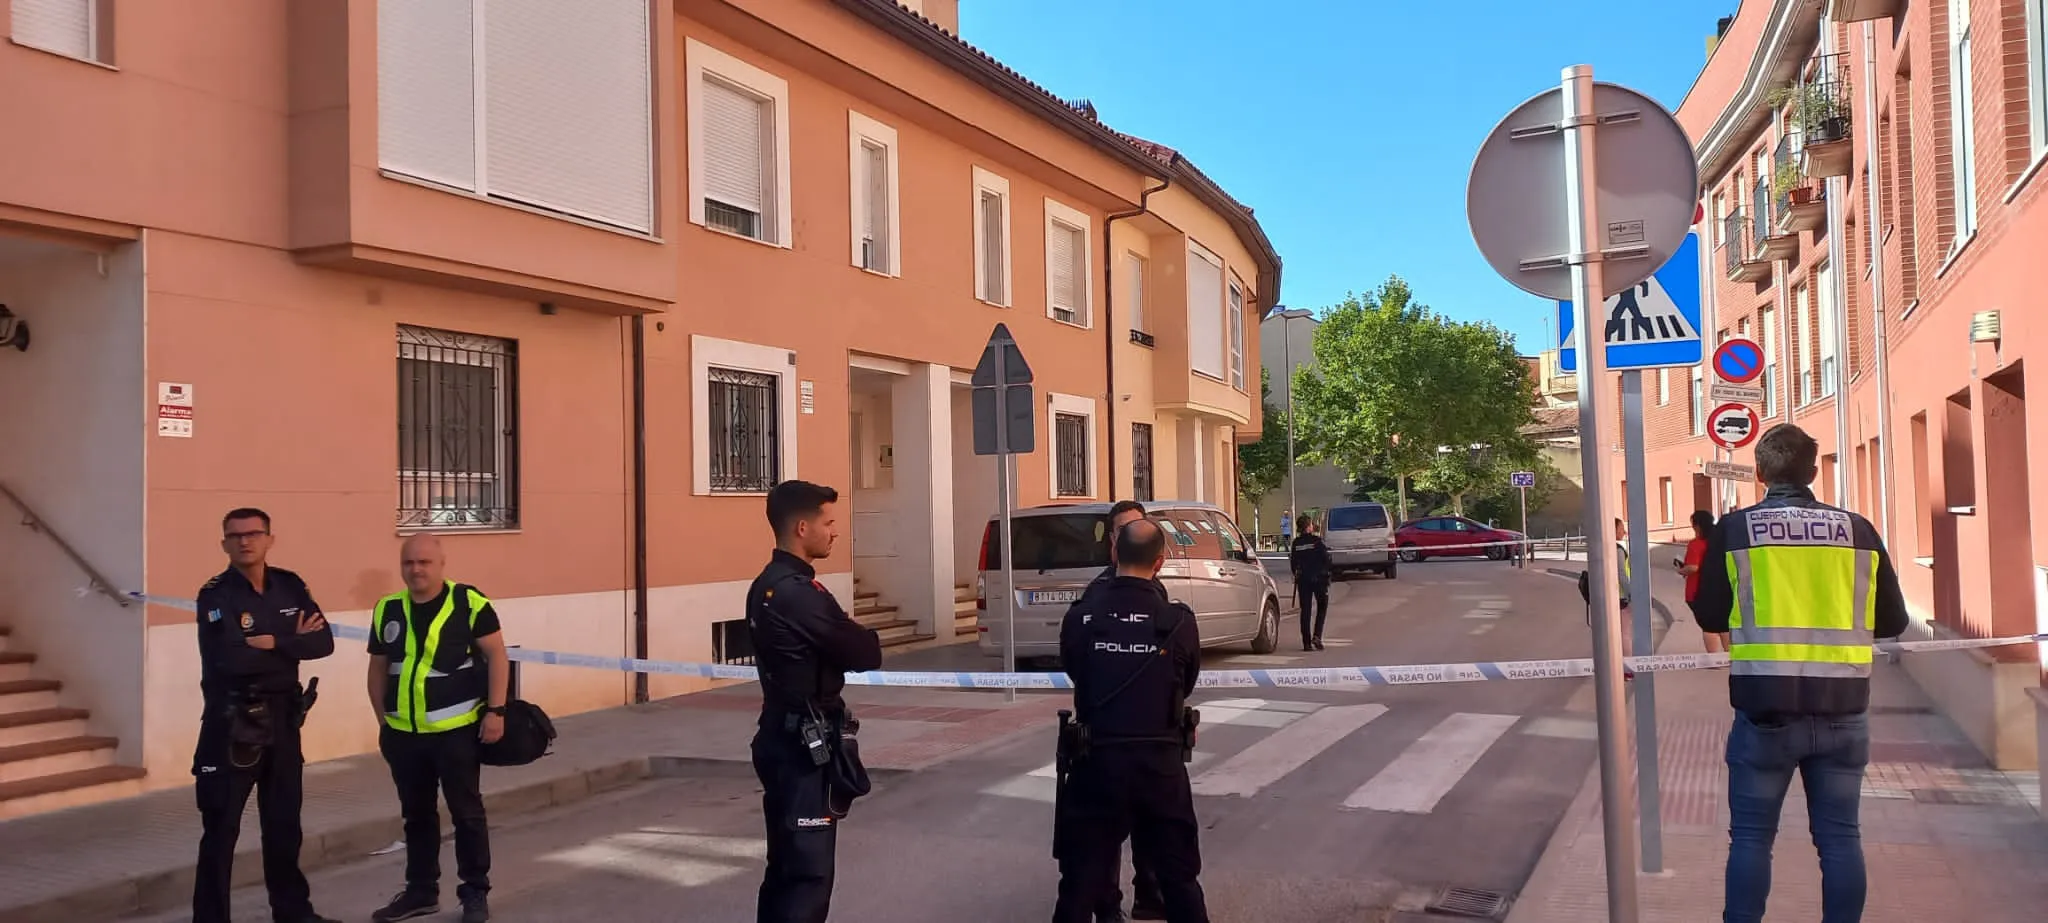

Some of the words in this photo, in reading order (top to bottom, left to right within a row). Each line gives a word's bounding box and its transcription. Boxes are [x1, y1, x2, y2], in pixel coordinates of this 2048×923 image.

[1750, 511, 1788, 520] CUERPO
[1790, 510, 1833, 520] NACIONAL
[1834, 513, 1848, 521] DE
[1751, 522, 1849, 542] POLICIA
[1094, 642, 1158, 653] POLICIA
